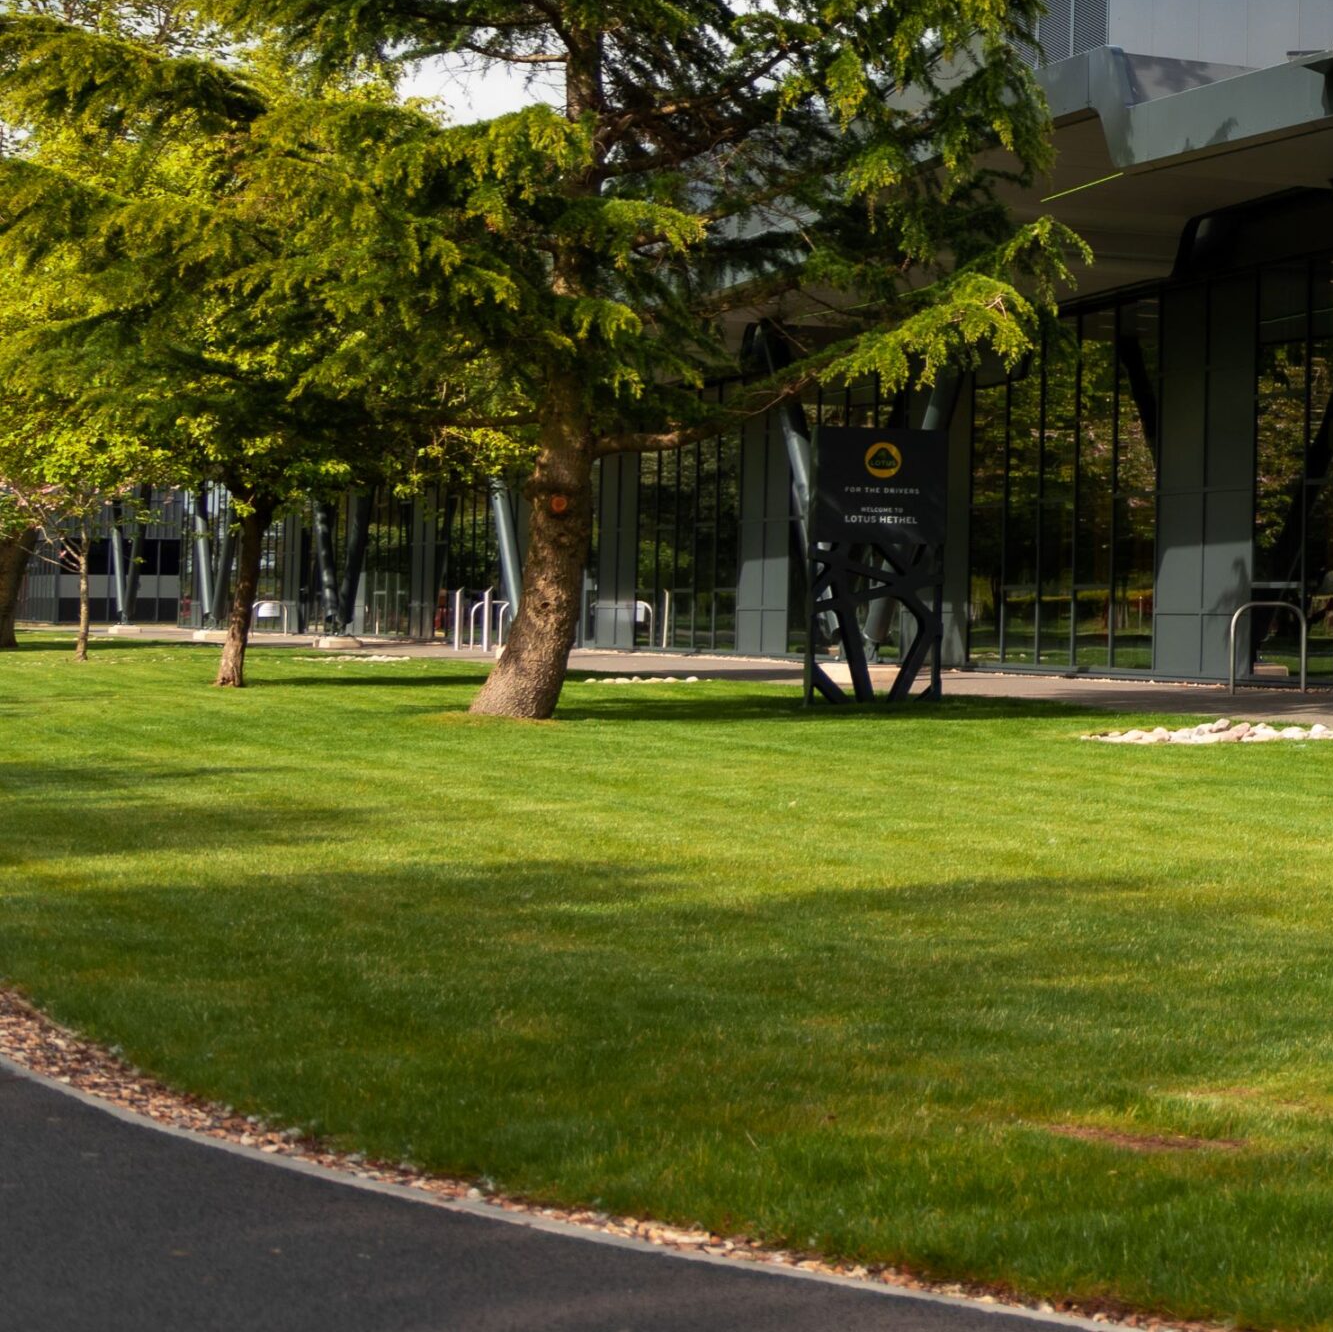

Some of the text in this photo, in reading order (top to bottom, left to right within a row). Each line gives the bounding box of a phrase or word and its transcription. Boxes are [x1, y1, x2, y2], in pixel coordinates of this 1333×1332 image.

[870, 459, 897, 467] LOTUS
[864, 486, 881, 494] THE
[883, 487, 920, 495] DRIVERS
[861, 506, 892, 514] WELCOME
[844, 515, 918, 525] LOTUS HETHEL
